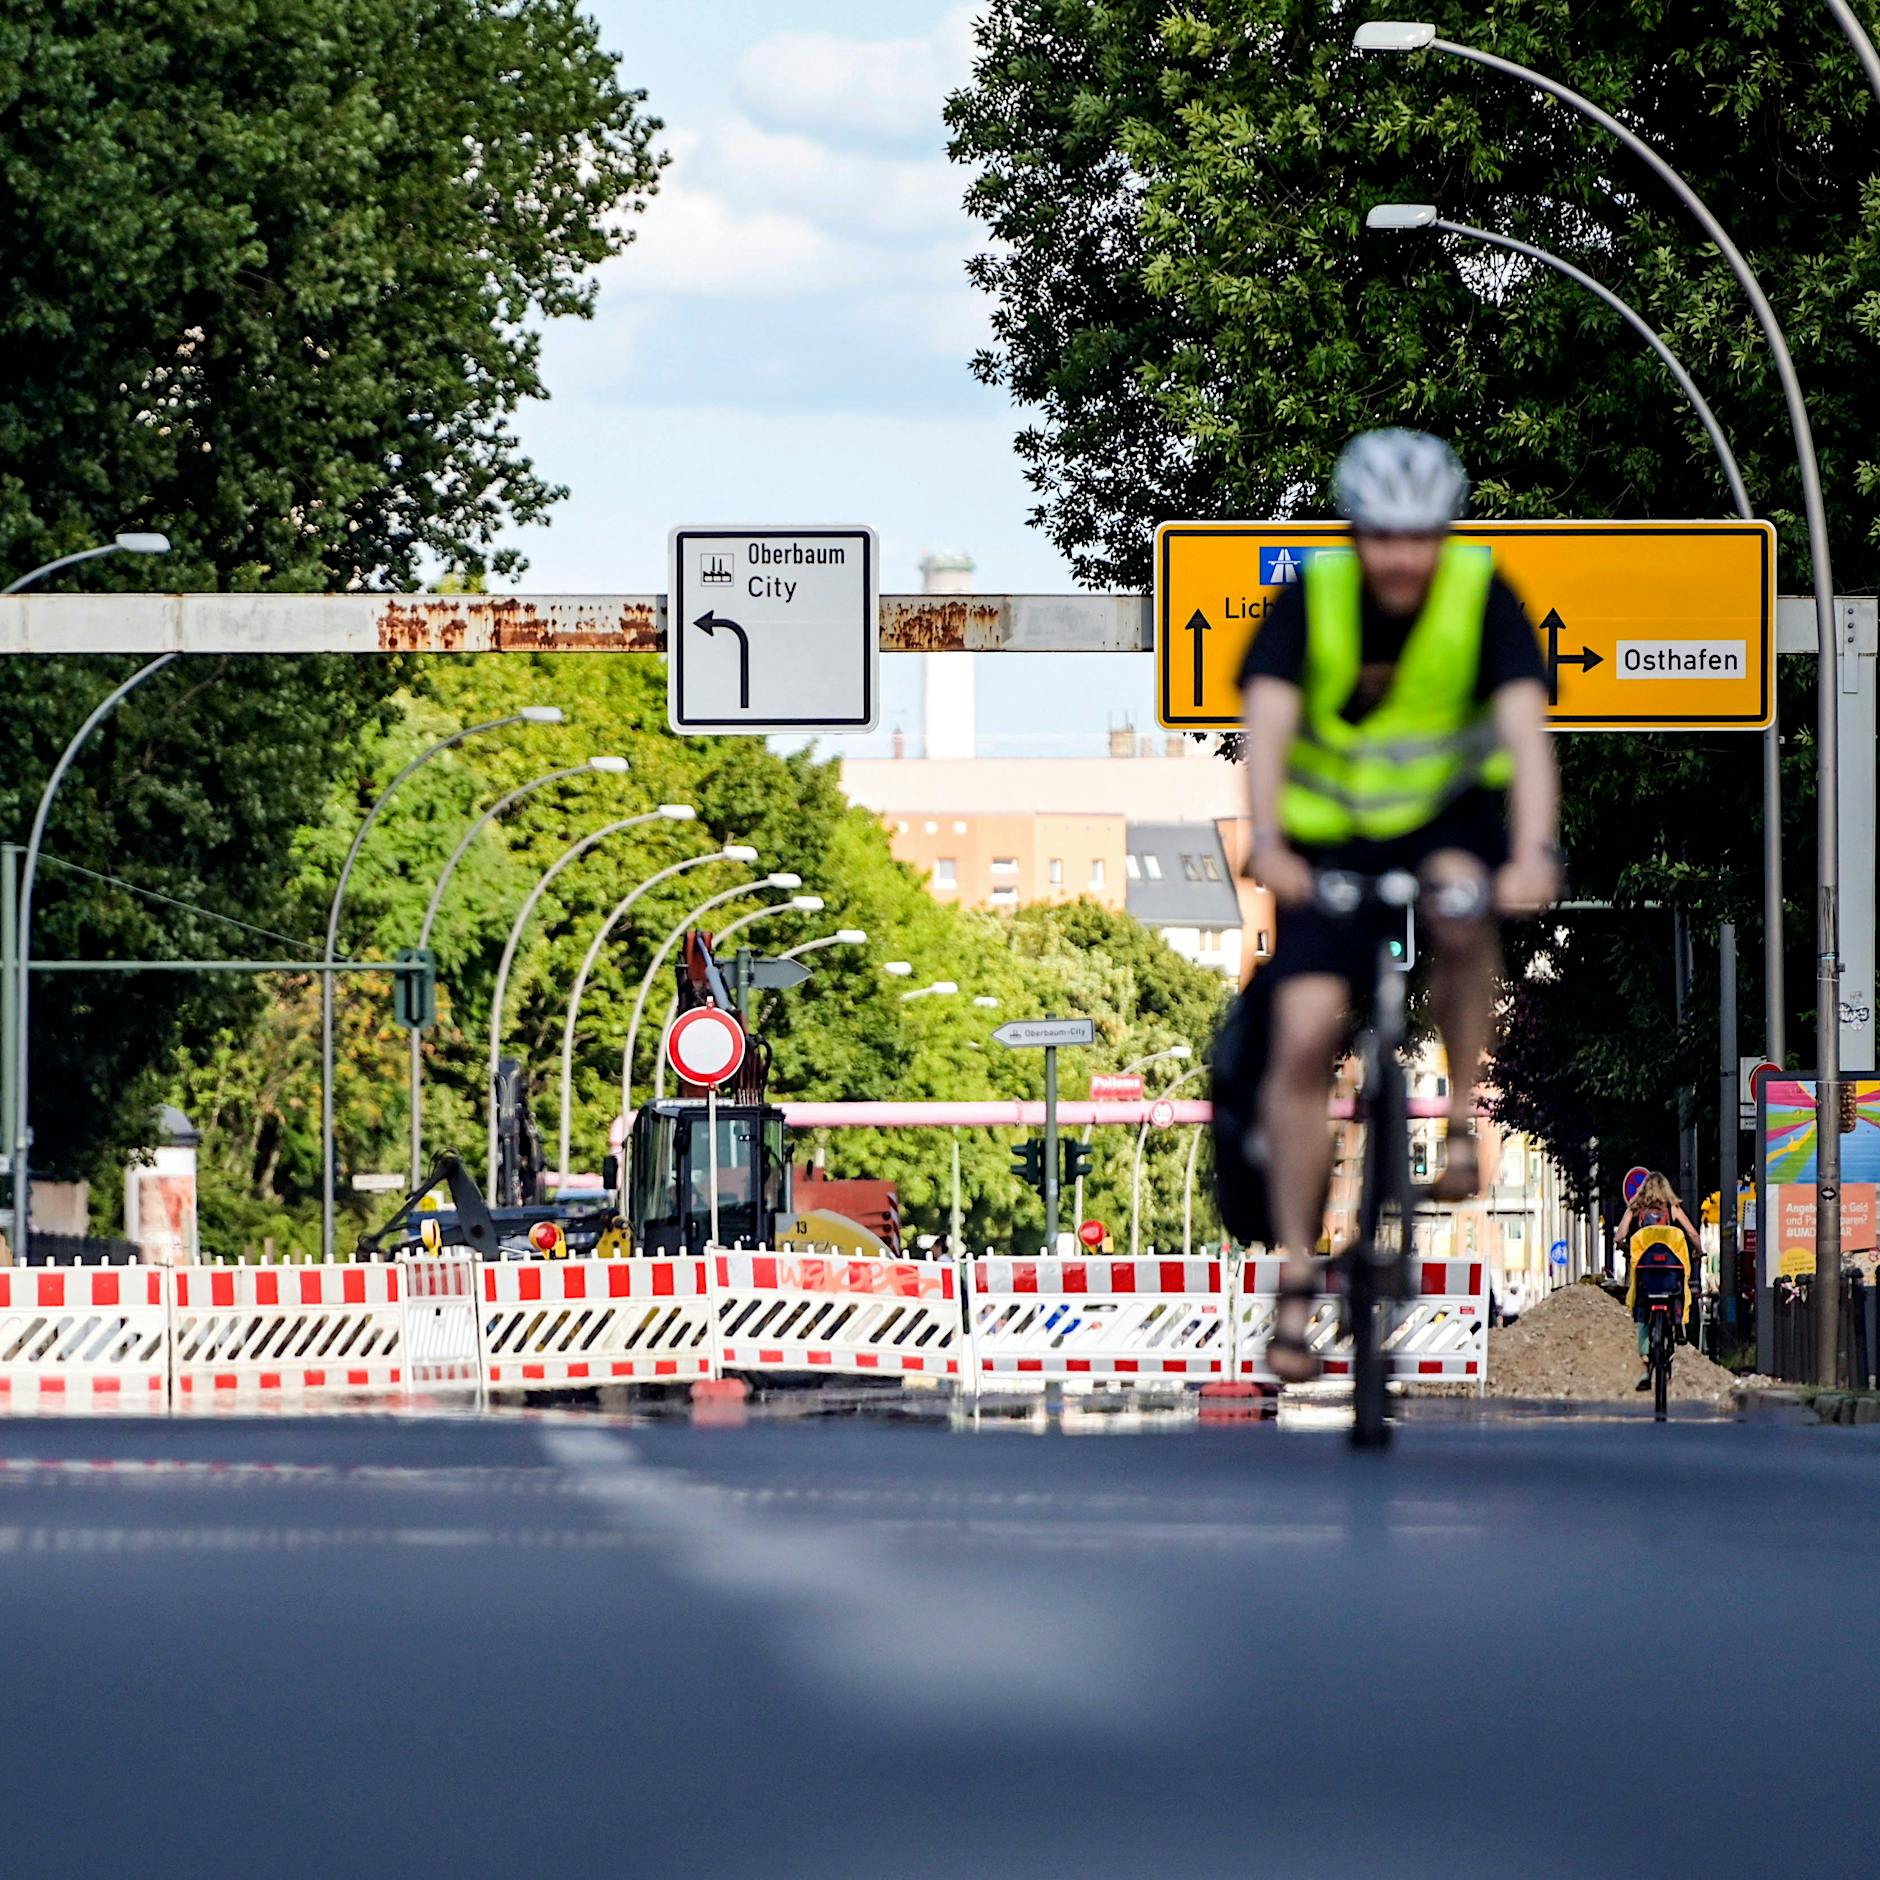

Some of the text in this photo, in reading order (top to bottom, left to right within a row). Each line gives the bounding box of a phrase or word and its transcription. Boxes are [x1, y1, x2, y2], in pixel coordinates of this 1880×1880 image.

[748, 542, 845, 565] Oberbaum
[748, 576, 797, 603] City
[1225, 596, 1274, 618] Lich
[1624, 648, 1738, 671] Osthafen
[1785, 1202, 1817, 1216] Angeb
[796, 1220, 807, 1234] 13
[1786, 1215, 1803, 1226] und
[1840, 1214, 1868, 1227] paren?
